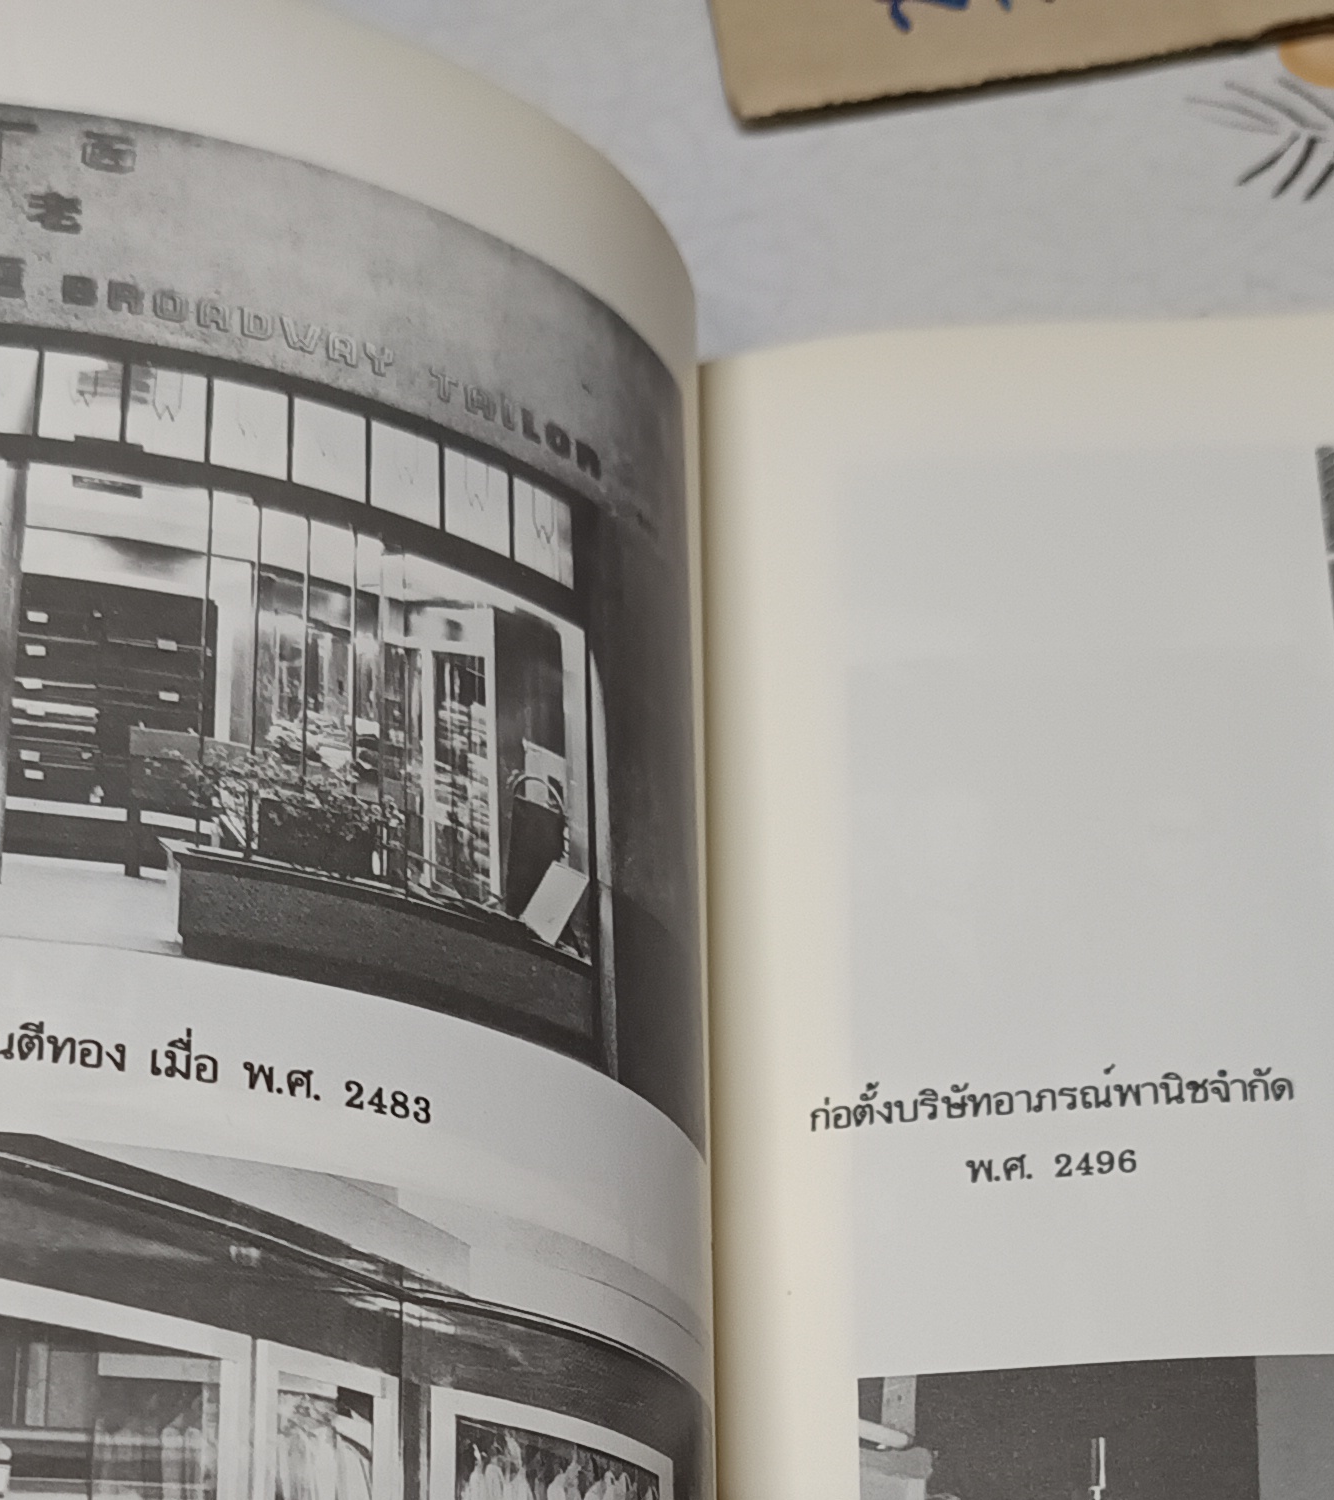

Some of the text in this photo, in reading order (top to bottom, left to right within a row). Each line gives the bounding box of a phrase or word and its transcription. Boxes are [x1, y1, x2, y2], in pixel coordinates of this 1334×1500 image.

[61, 274, 601, 481] BROADWAY TAILOR
[149, 1026, 220, 1085] เมื่อ
[241, 1056, 322, 1103] พ.ศ.
[343, 1078, 434, 1126] 2483
[809, 1062, 1296, 1133] ก่อตั้งบริษัทอาภรณ์พานิชจำกัด
[964, 1147, 1139, 1185] พ.ศ. 2496
